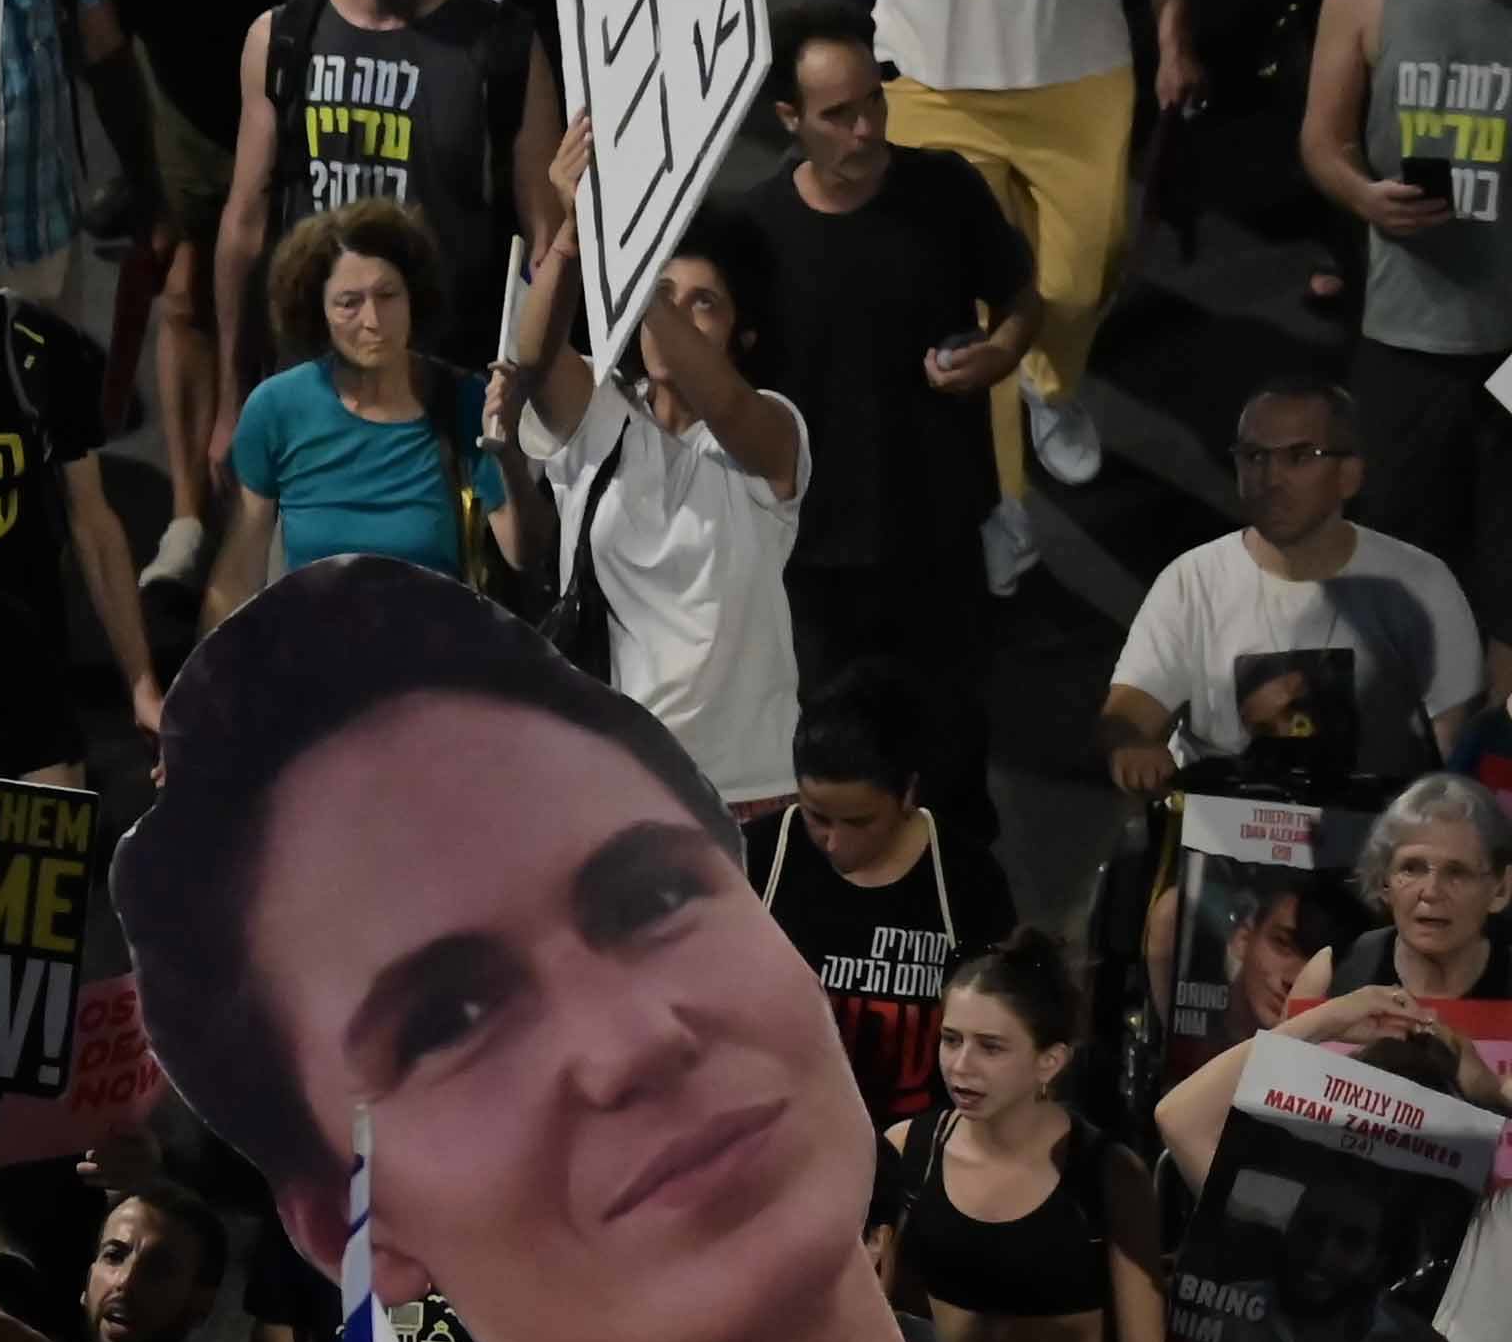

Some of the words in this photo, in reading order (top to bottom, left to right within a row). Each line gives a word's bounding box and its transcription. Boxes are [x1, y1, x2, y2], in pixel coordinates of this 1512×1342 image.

[350, 55, 420, 110] למה
[1398, 61, 1441, 108] הם
[1447, 61, 1511, 112] למה
[305, 105, 413, 161] עדיין
[1399, 109, 1508, 163] עדיין
[870, 924, 948, 967] מחזירים
[823, 953, 889, 997] הביתה
[893, 959, 945, 999] אותם
[1176, 980, 1229, 1010] BRING
[1174, 1008, 1208, 1037] HIM
[1263, 1088, 1334, 1124] MATAN
[1393, 1101, 1426, 1132] מתן
[1178, 1274, 1265, 1321] BRING
